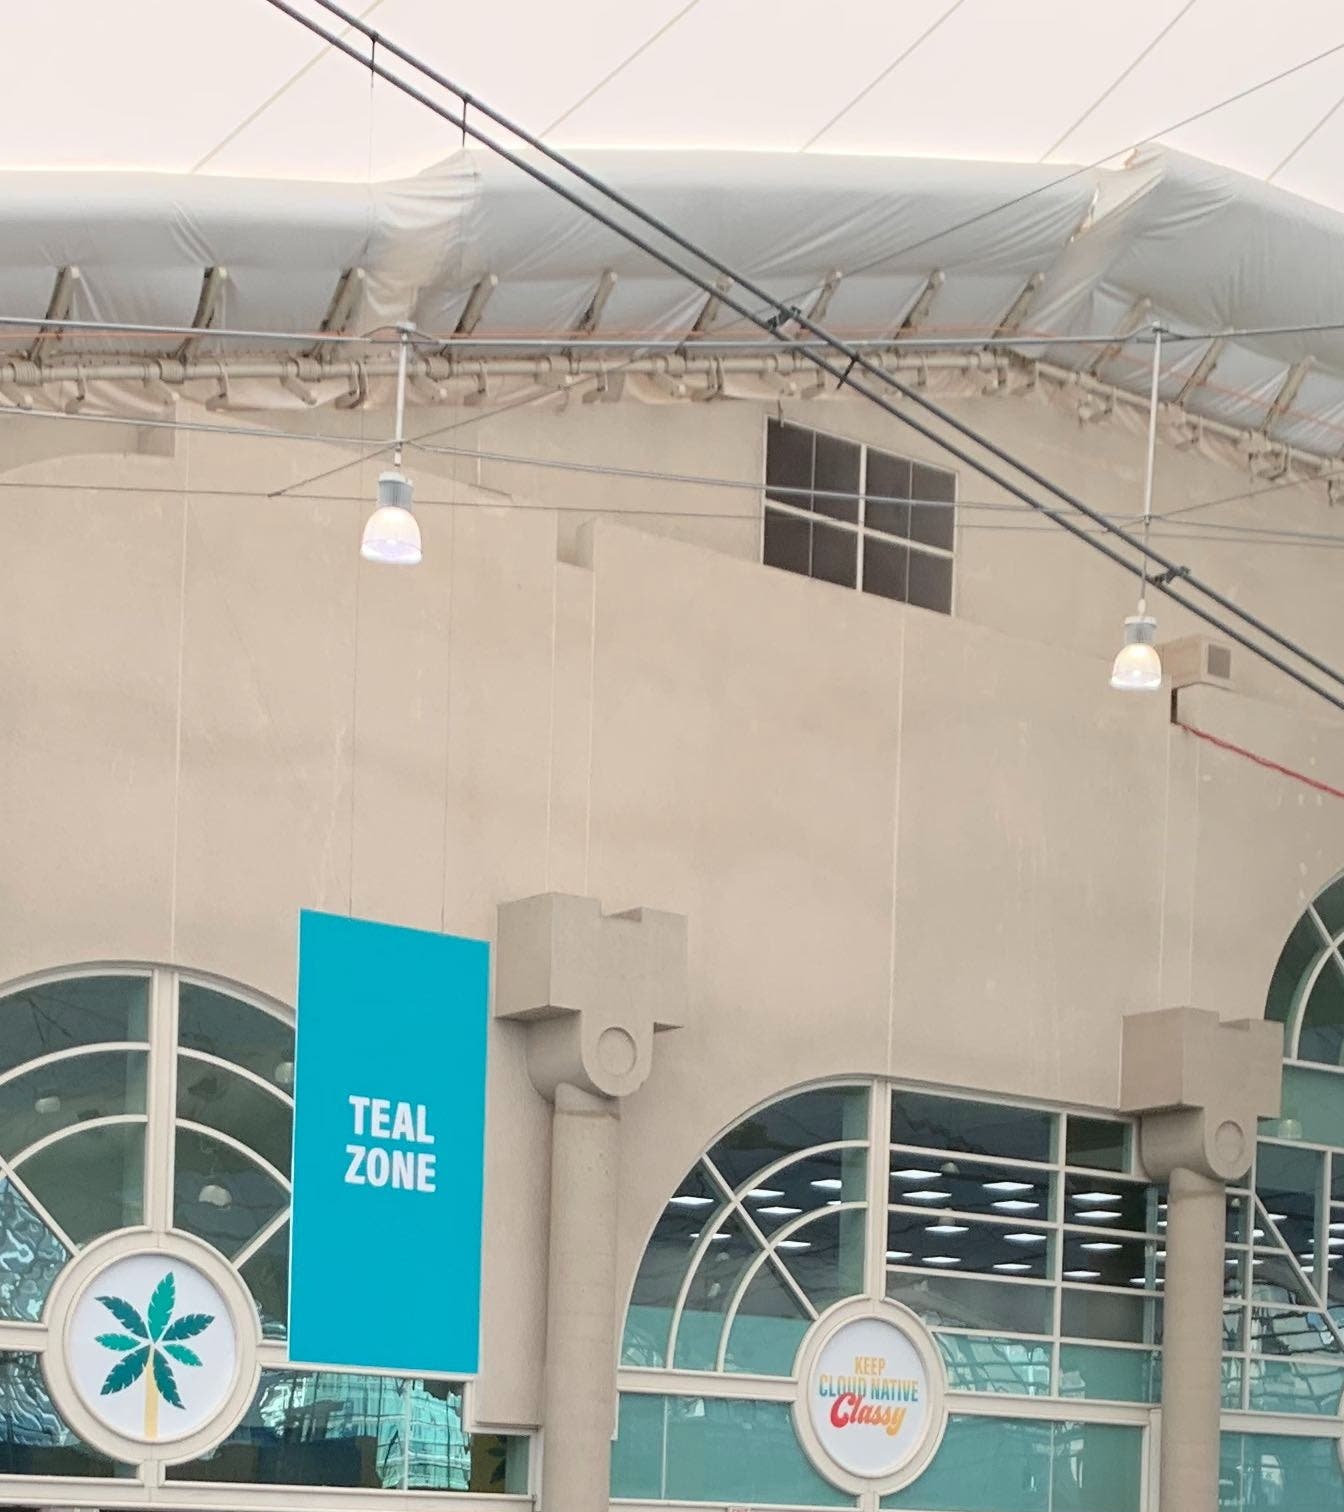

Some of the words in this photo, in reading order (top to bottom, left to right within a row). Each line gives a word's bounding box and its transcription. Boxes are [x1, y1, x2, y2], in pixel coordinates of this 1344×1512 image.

[349, 1096, 434, 1143] TEAL
[345, 1144, 436, 1192] ZONE
[819, 1374, 866, 1399] CLOUD
[871, 1378, 918, 1402] NATIVE
[855, 1356, 885, 1376] KEEP
[830, 1391, 907, 1436] Classy
